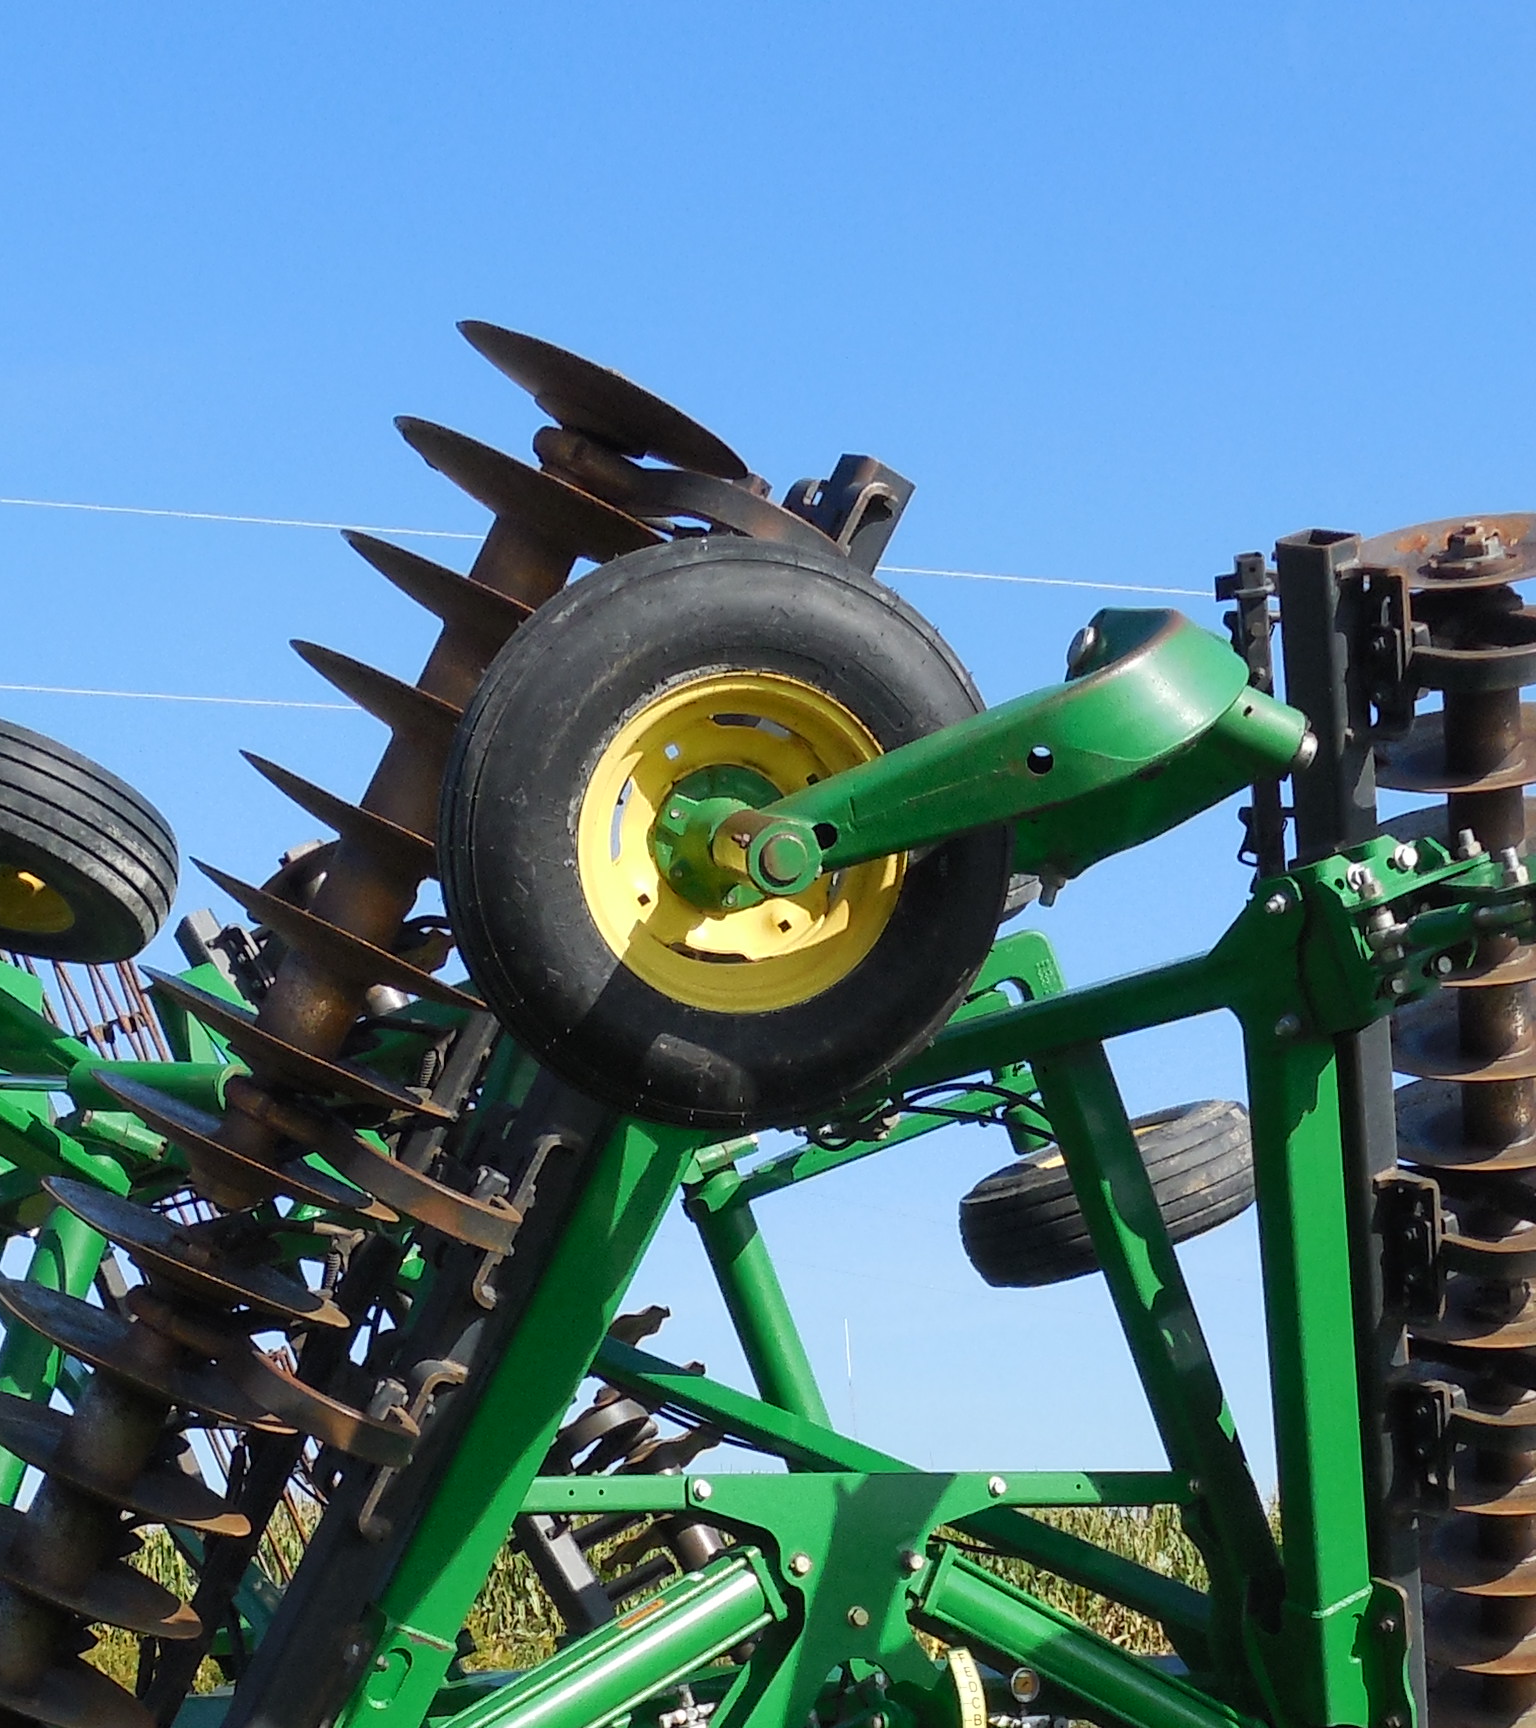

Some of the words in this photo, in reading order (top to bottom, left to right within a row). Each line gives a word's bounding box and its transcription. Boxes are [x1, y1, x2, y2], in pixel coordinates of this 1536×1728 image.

[964, 1667, 973, 1677] E
[968, 1681, 978, 1692] D
[971, 1697, 981, 1709] C
[974, 1713, 982, 1726] B
